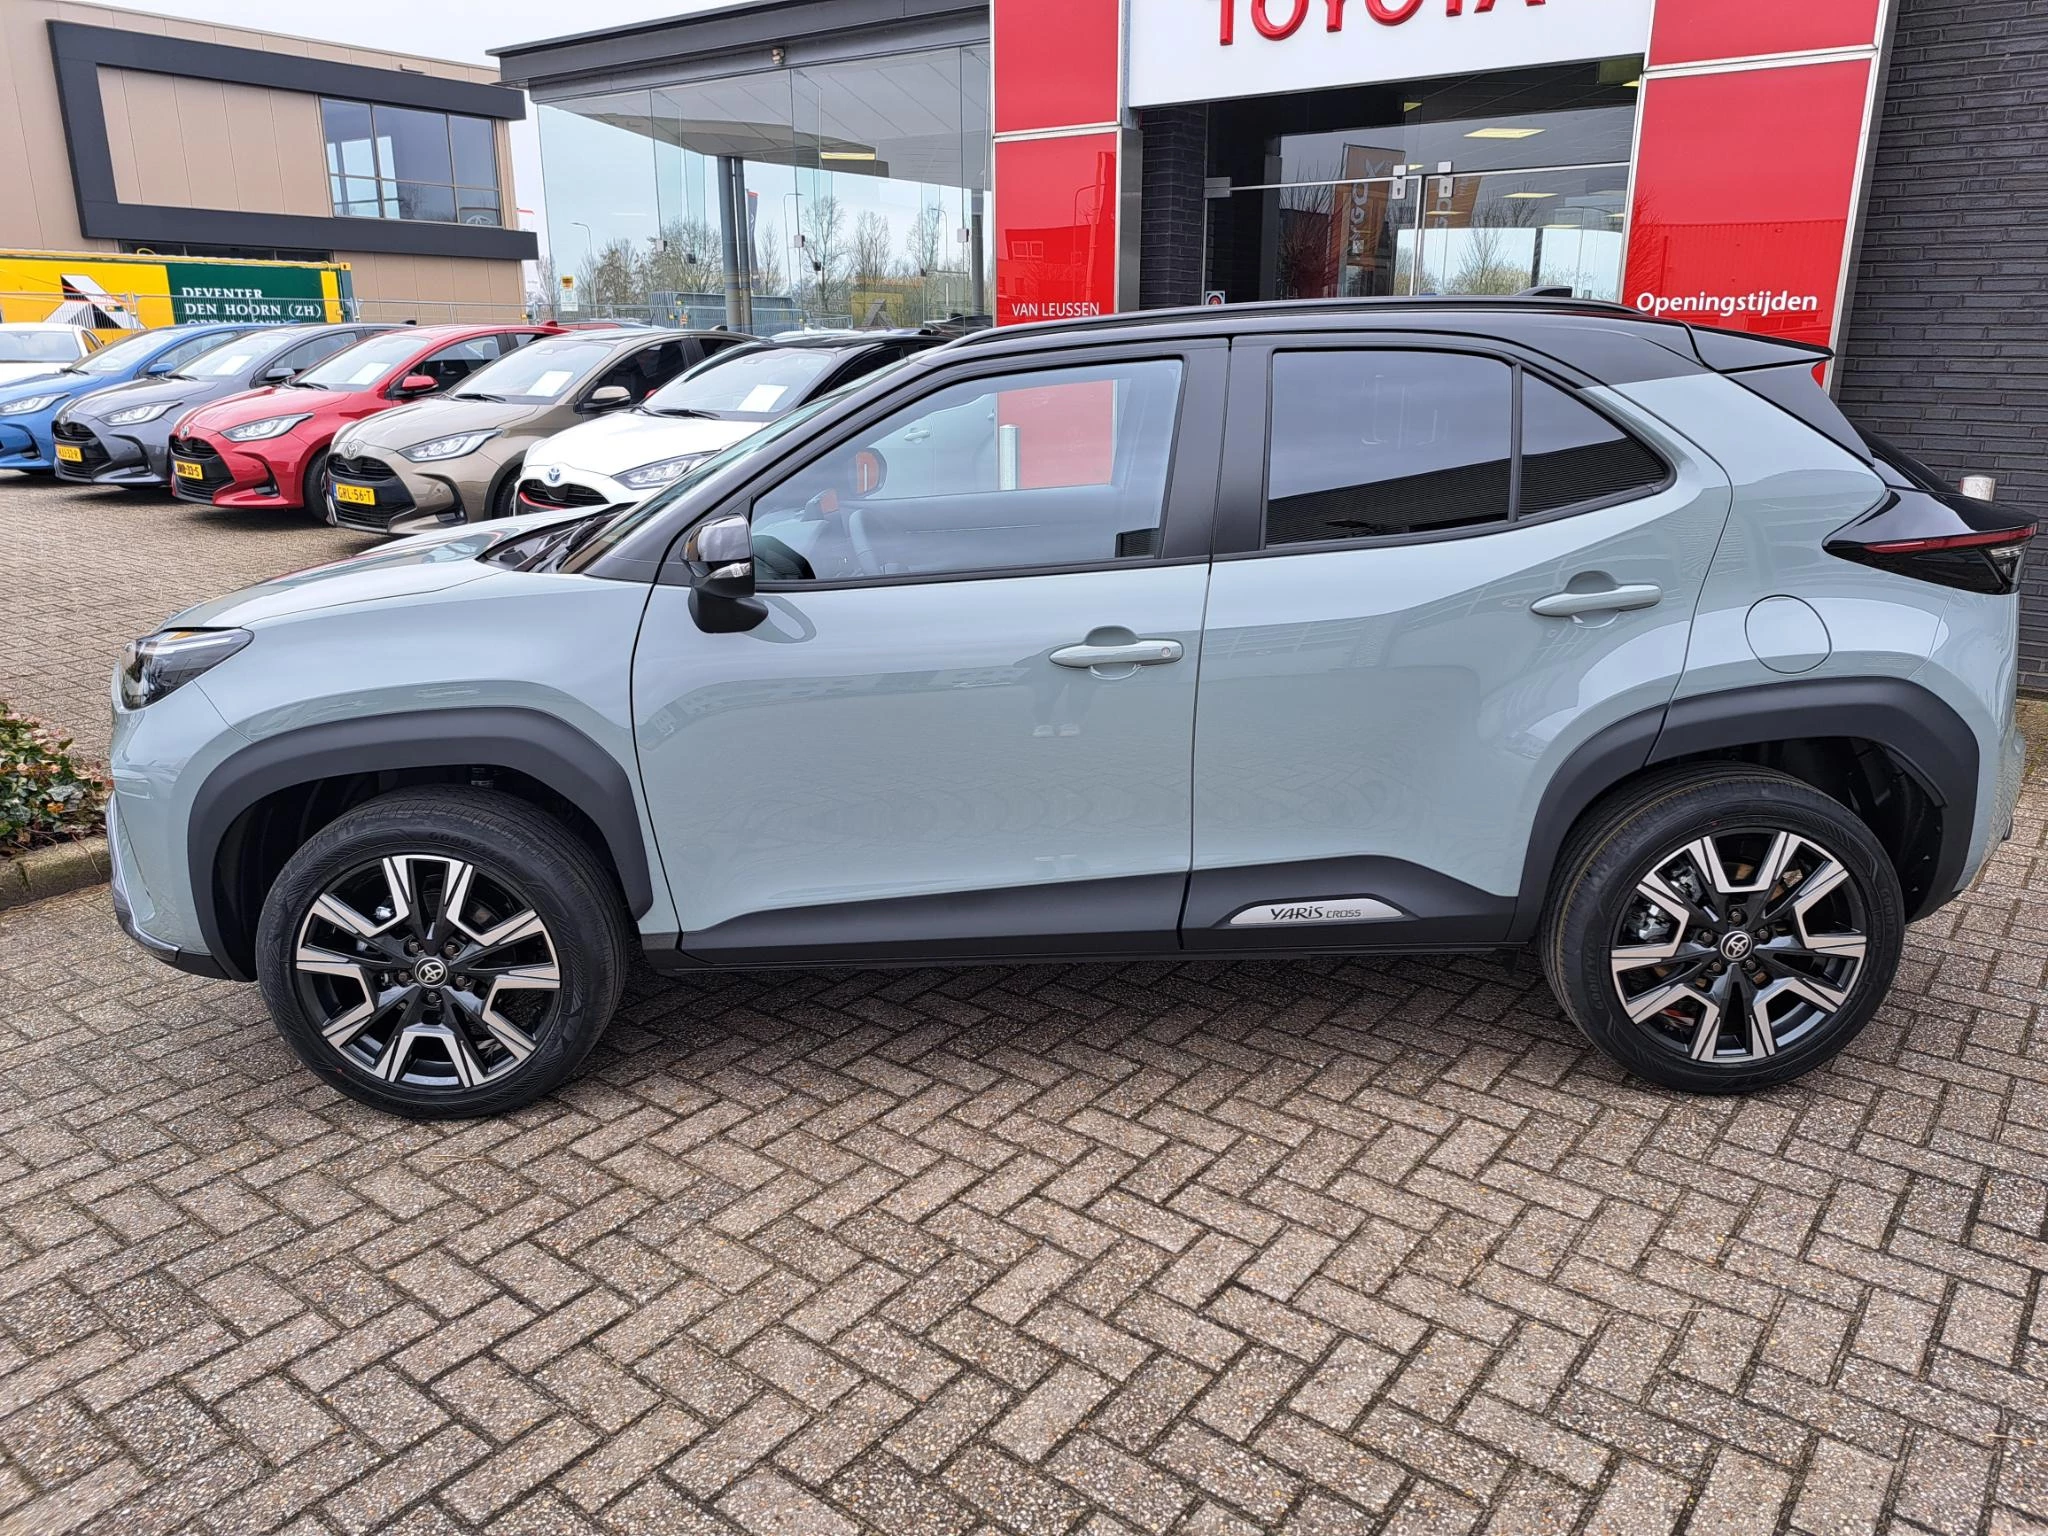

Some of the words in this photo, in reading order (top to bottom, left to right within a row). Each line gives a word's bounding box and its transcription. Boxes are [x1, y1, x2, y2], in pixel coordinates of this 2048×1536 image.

[1220, 0, 1546, 45] TOY
[182, 287, 263, 299] DEVENTER
[184, 303, 217, 315] DEN
[225, 303, 281, 316] HOORN
[288, 303, 321, 317] (ZH)
[1011, 303, 1039, 317] VAN
[1041, 302, 1100, 316] LEUSSEN
[1636, 290, 1817, 317] Openingstijden
[337, 486, 372, 503] GRL-56-T
[1326, 909, 1362, 919] CROSS
